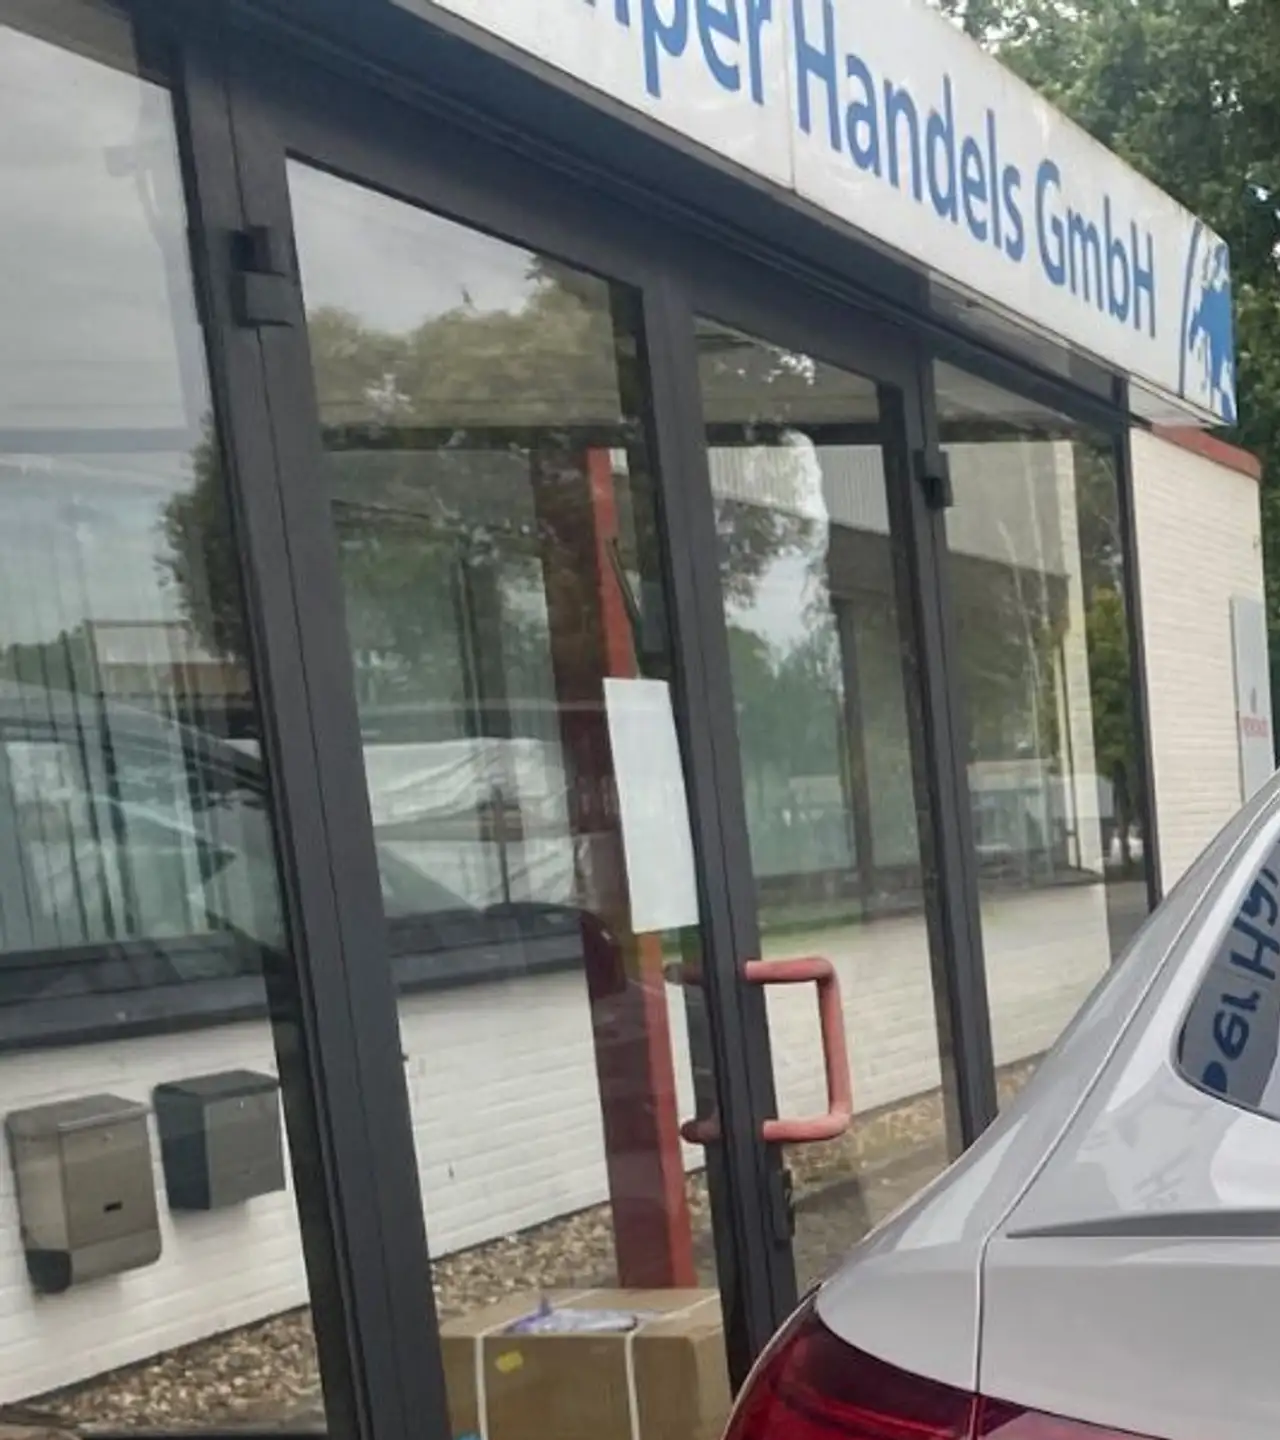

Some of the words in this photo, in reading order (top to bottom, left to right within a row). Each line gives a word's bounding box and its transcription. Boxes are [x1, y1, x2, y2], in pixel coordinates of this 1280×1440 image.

[582, 0, 772, 106] per
[792, 0, 1025, 262] Handels
[1035, 158, 1156, 339] GmbH
